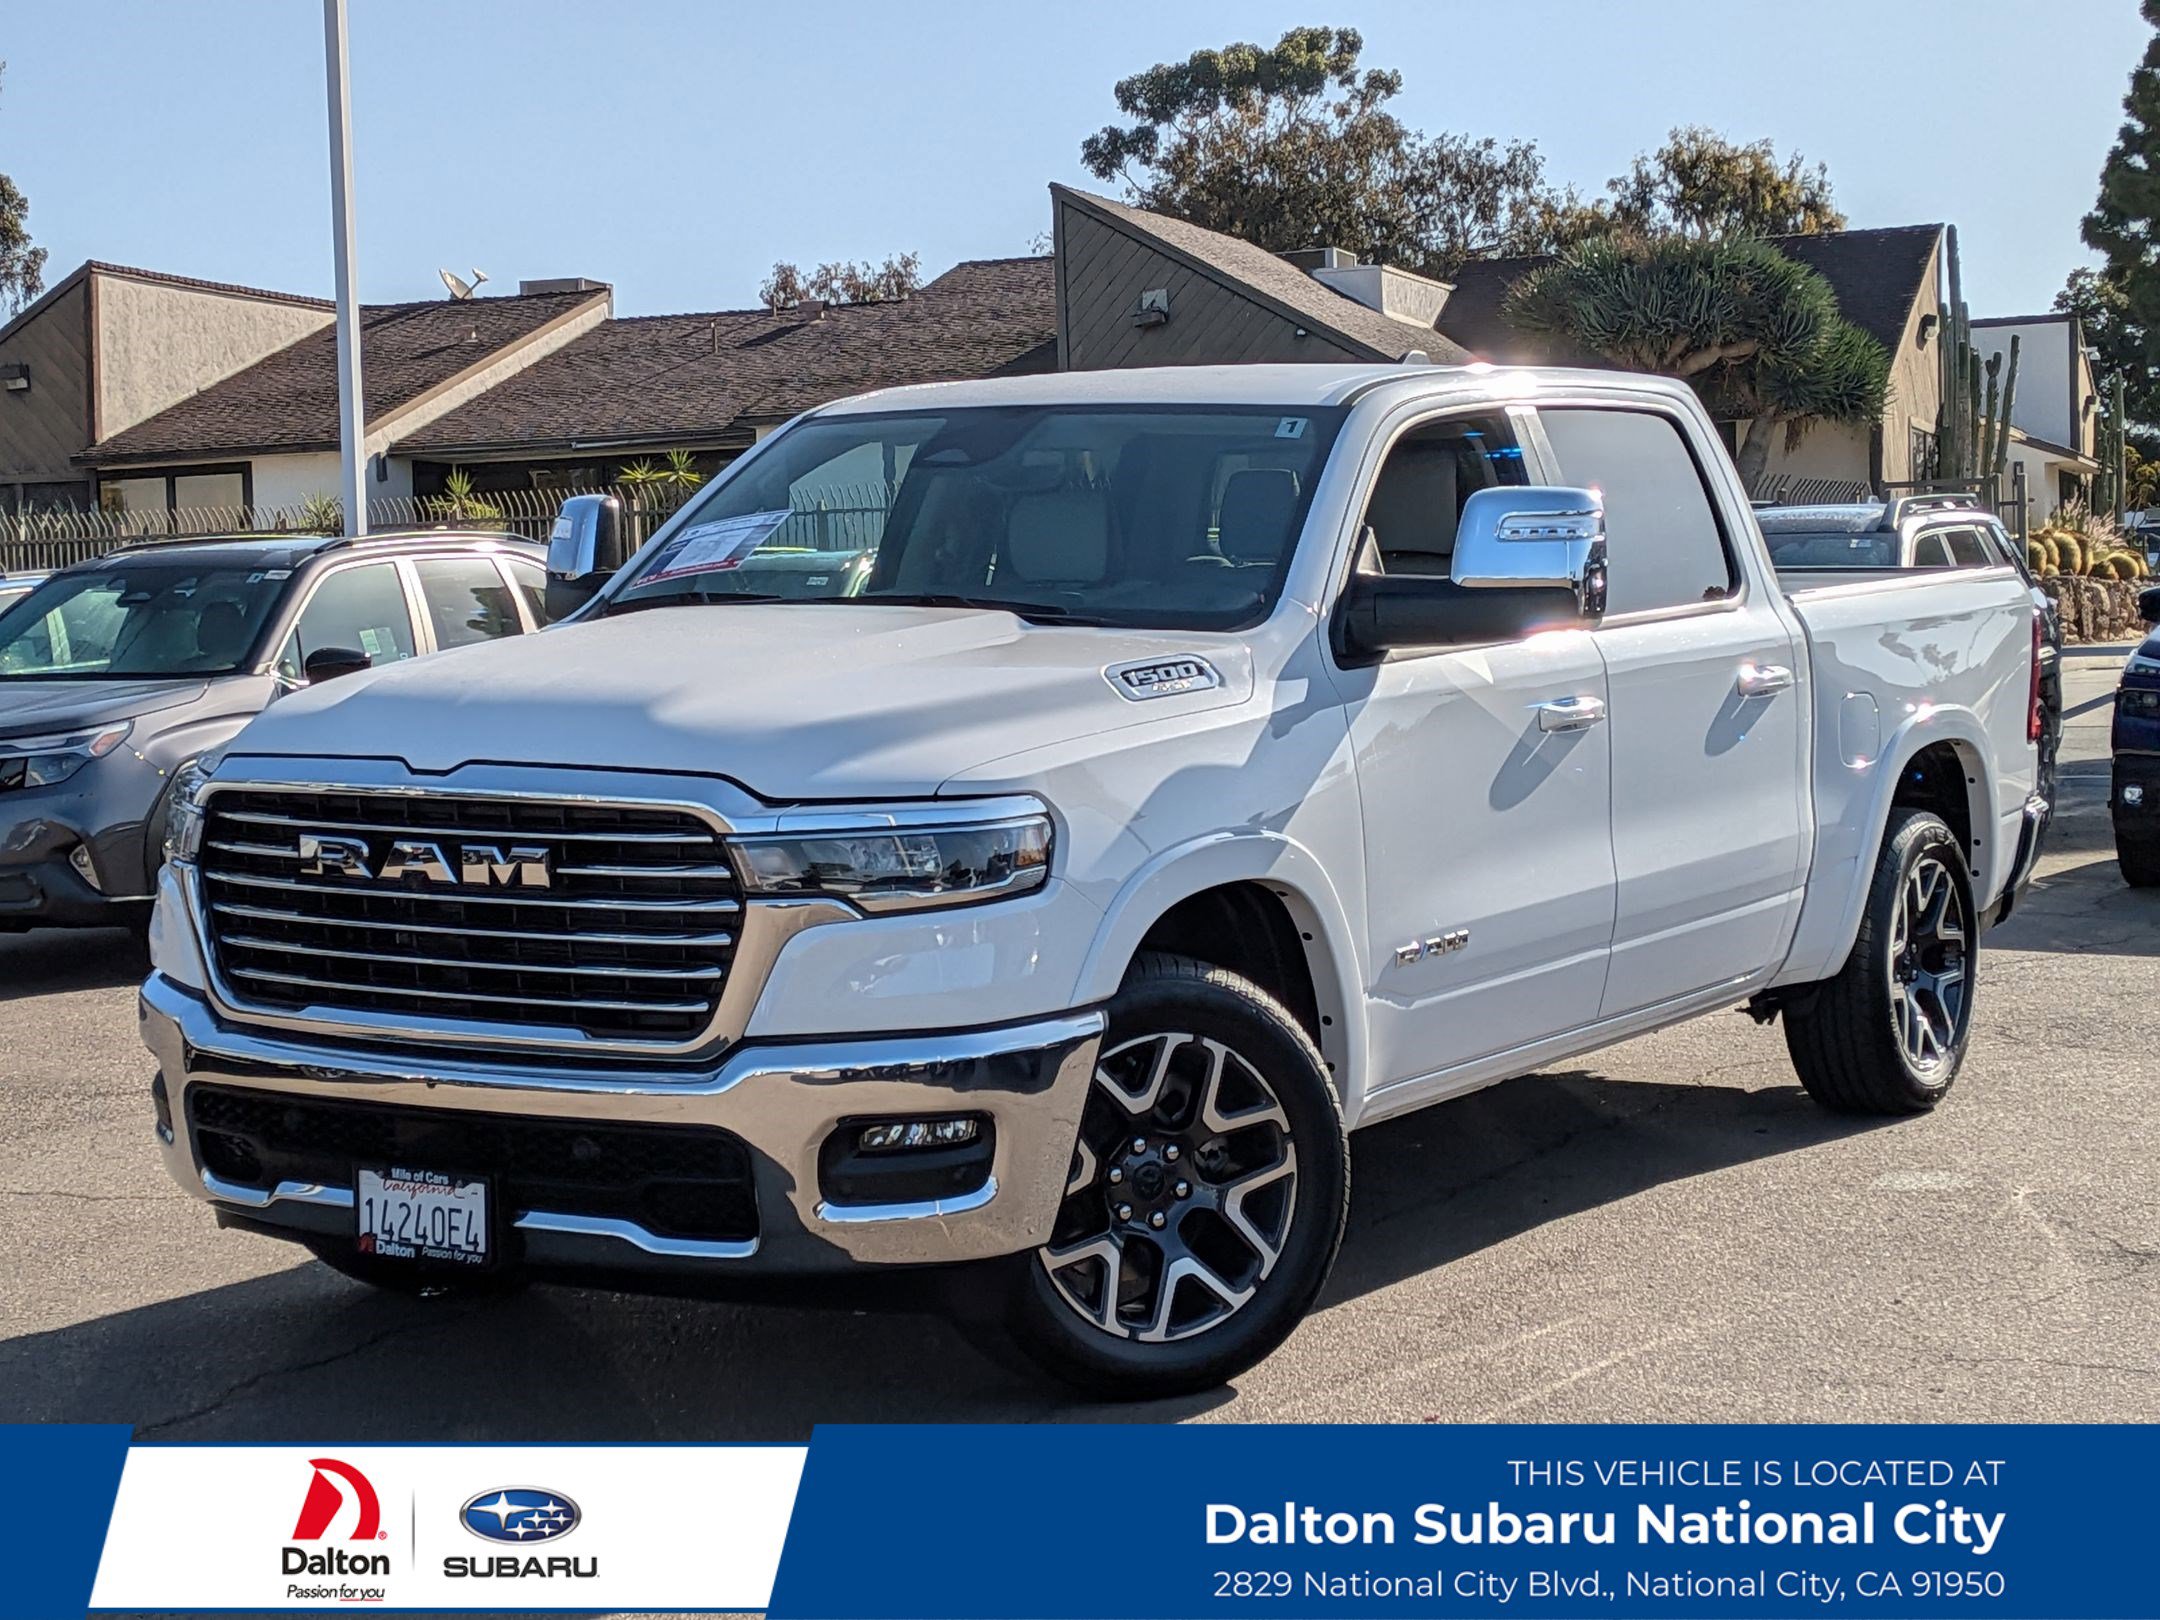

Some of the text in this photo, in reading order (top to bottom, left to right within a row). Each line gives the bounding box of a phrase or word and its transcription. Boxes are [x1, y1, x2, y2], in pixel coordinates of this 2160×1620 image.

[1124, 662, 1199, 686] 1500
[300, 834, 550, 888] RAM
[391, 1168, 449, 1185] Mile of Cars
[365, 1197, 480, 1251] 14240E4
[376, 1240, 415, 1258] Dalton
[421, 1247, 483, 1264] Passion for you
